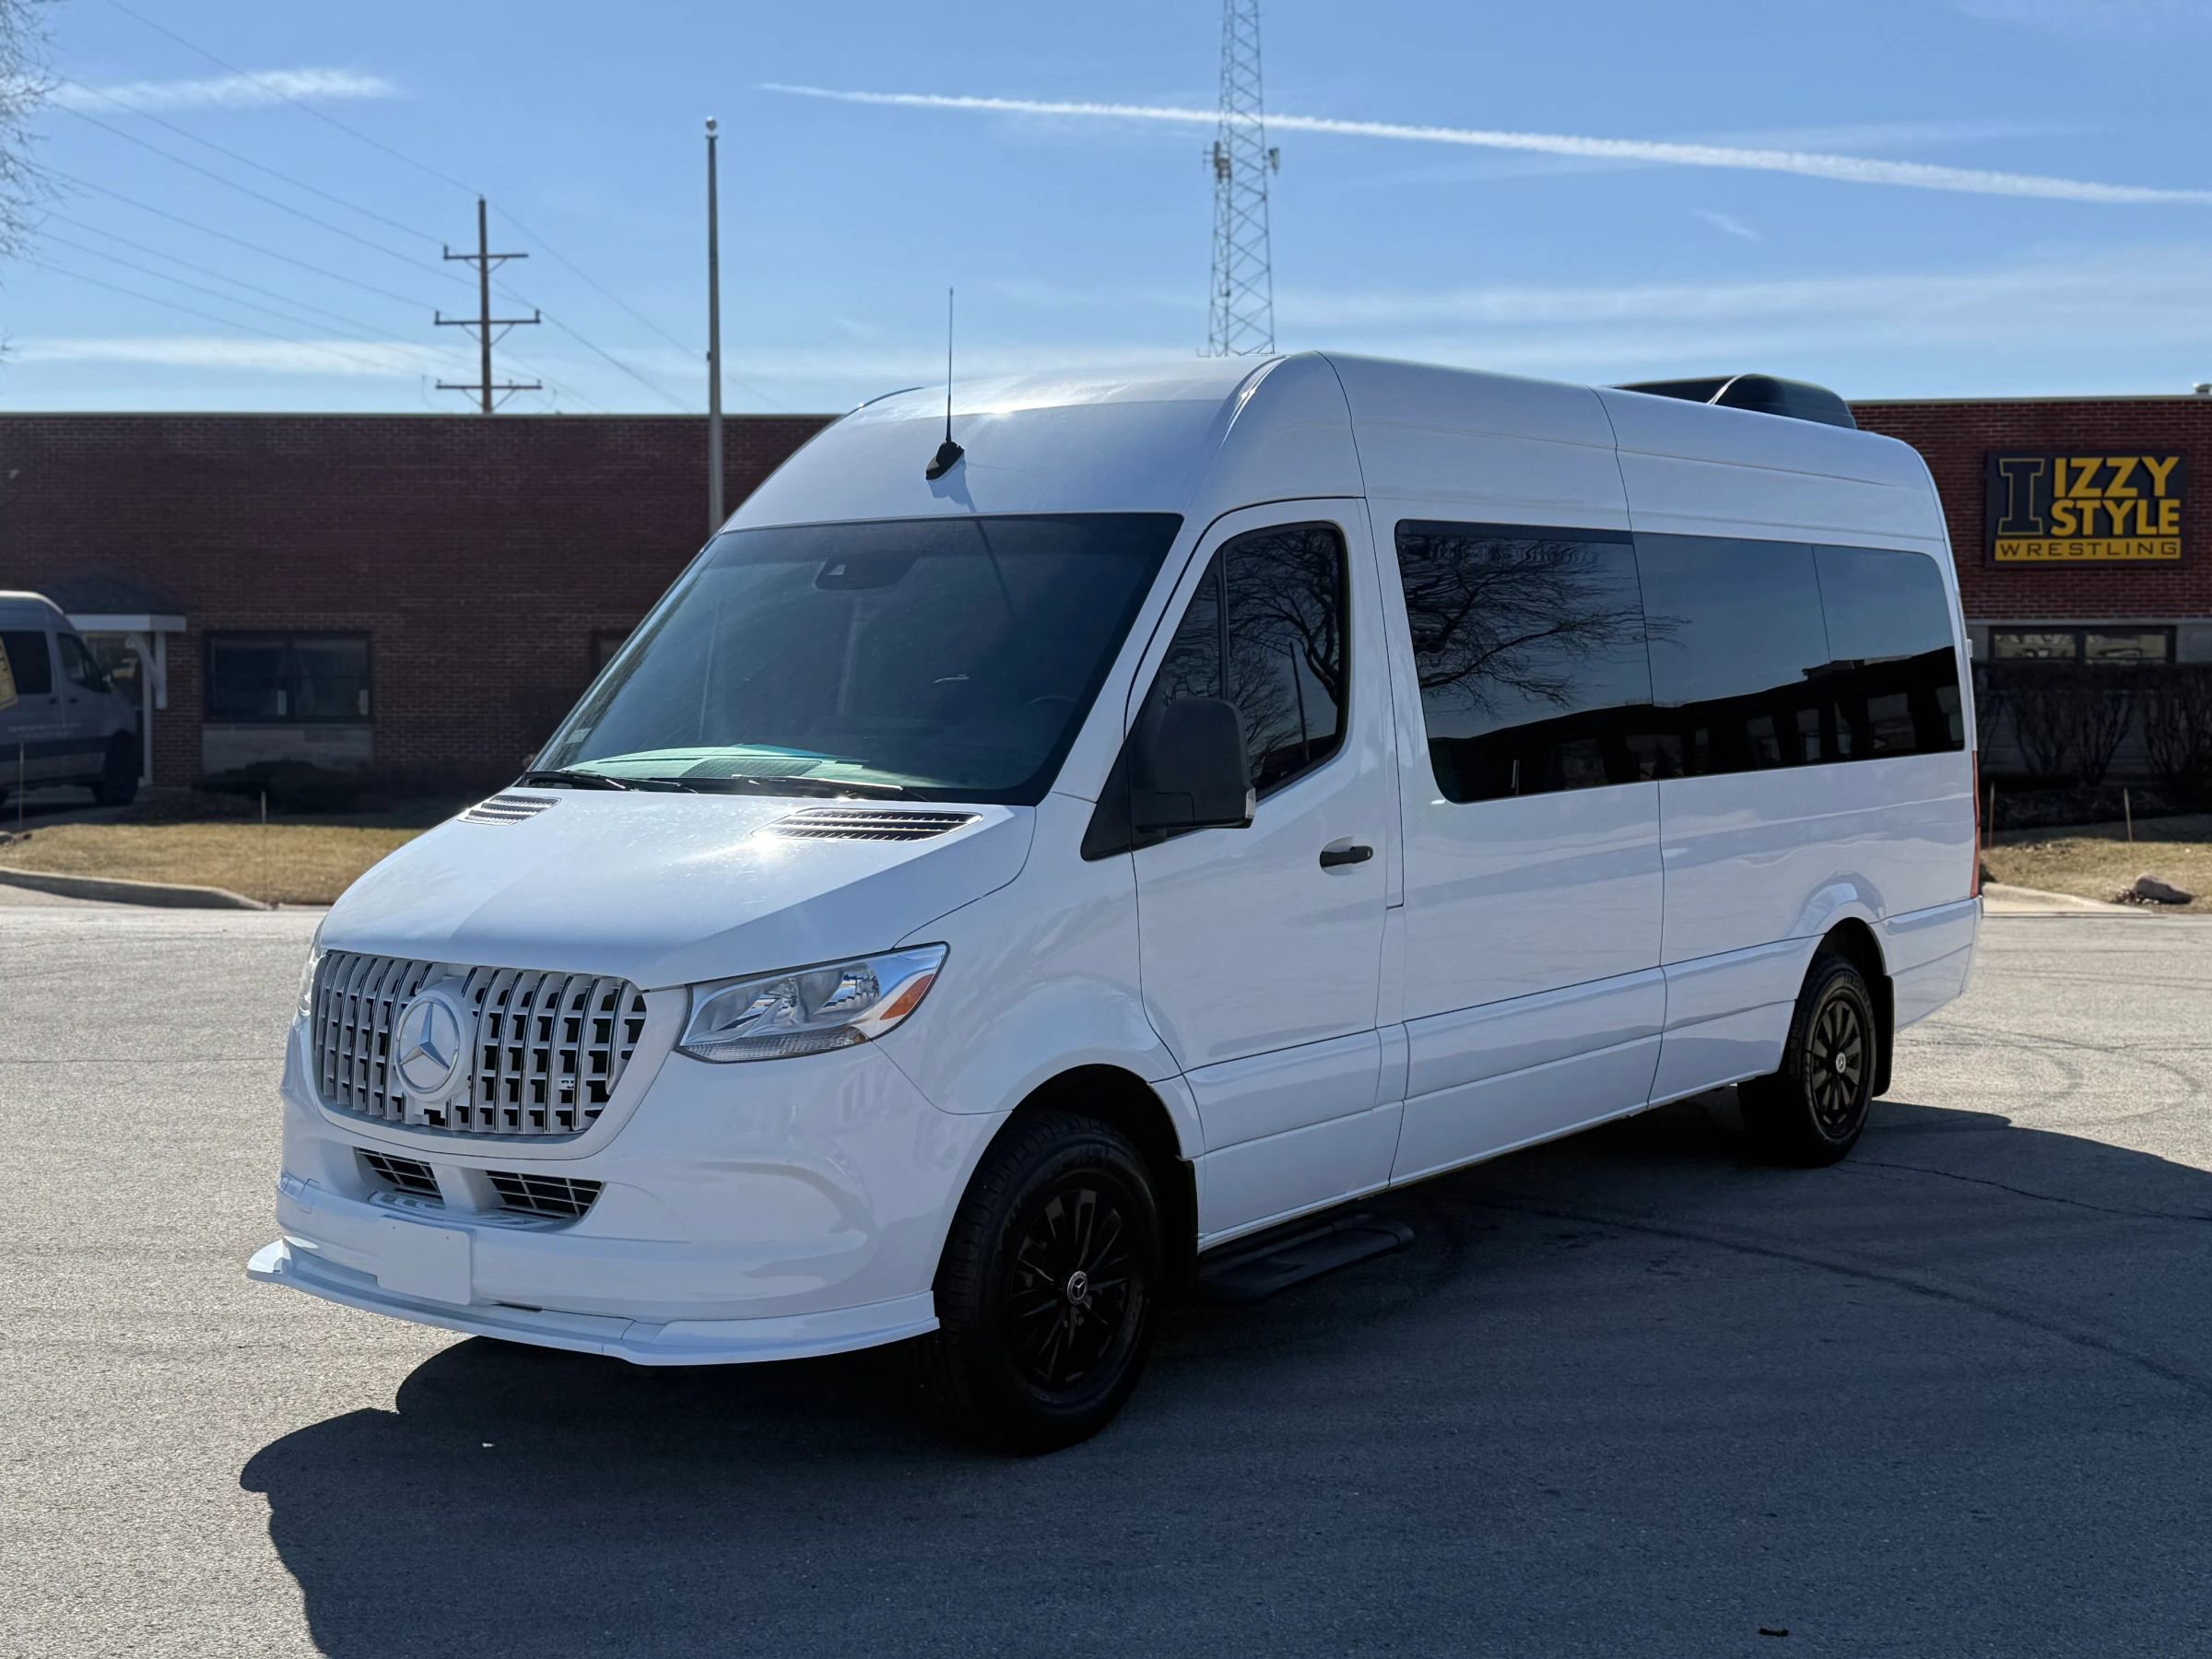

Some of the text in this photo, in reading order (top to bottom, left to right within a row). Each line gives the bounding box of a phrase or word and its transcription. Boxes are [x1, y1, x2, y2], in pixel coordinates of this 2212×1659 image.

[2054, 456, 2180, 498] IZZY
[2051, 500, 2180, 536] STYLE
[2000, 542, 2177, 557] WRESTLING
